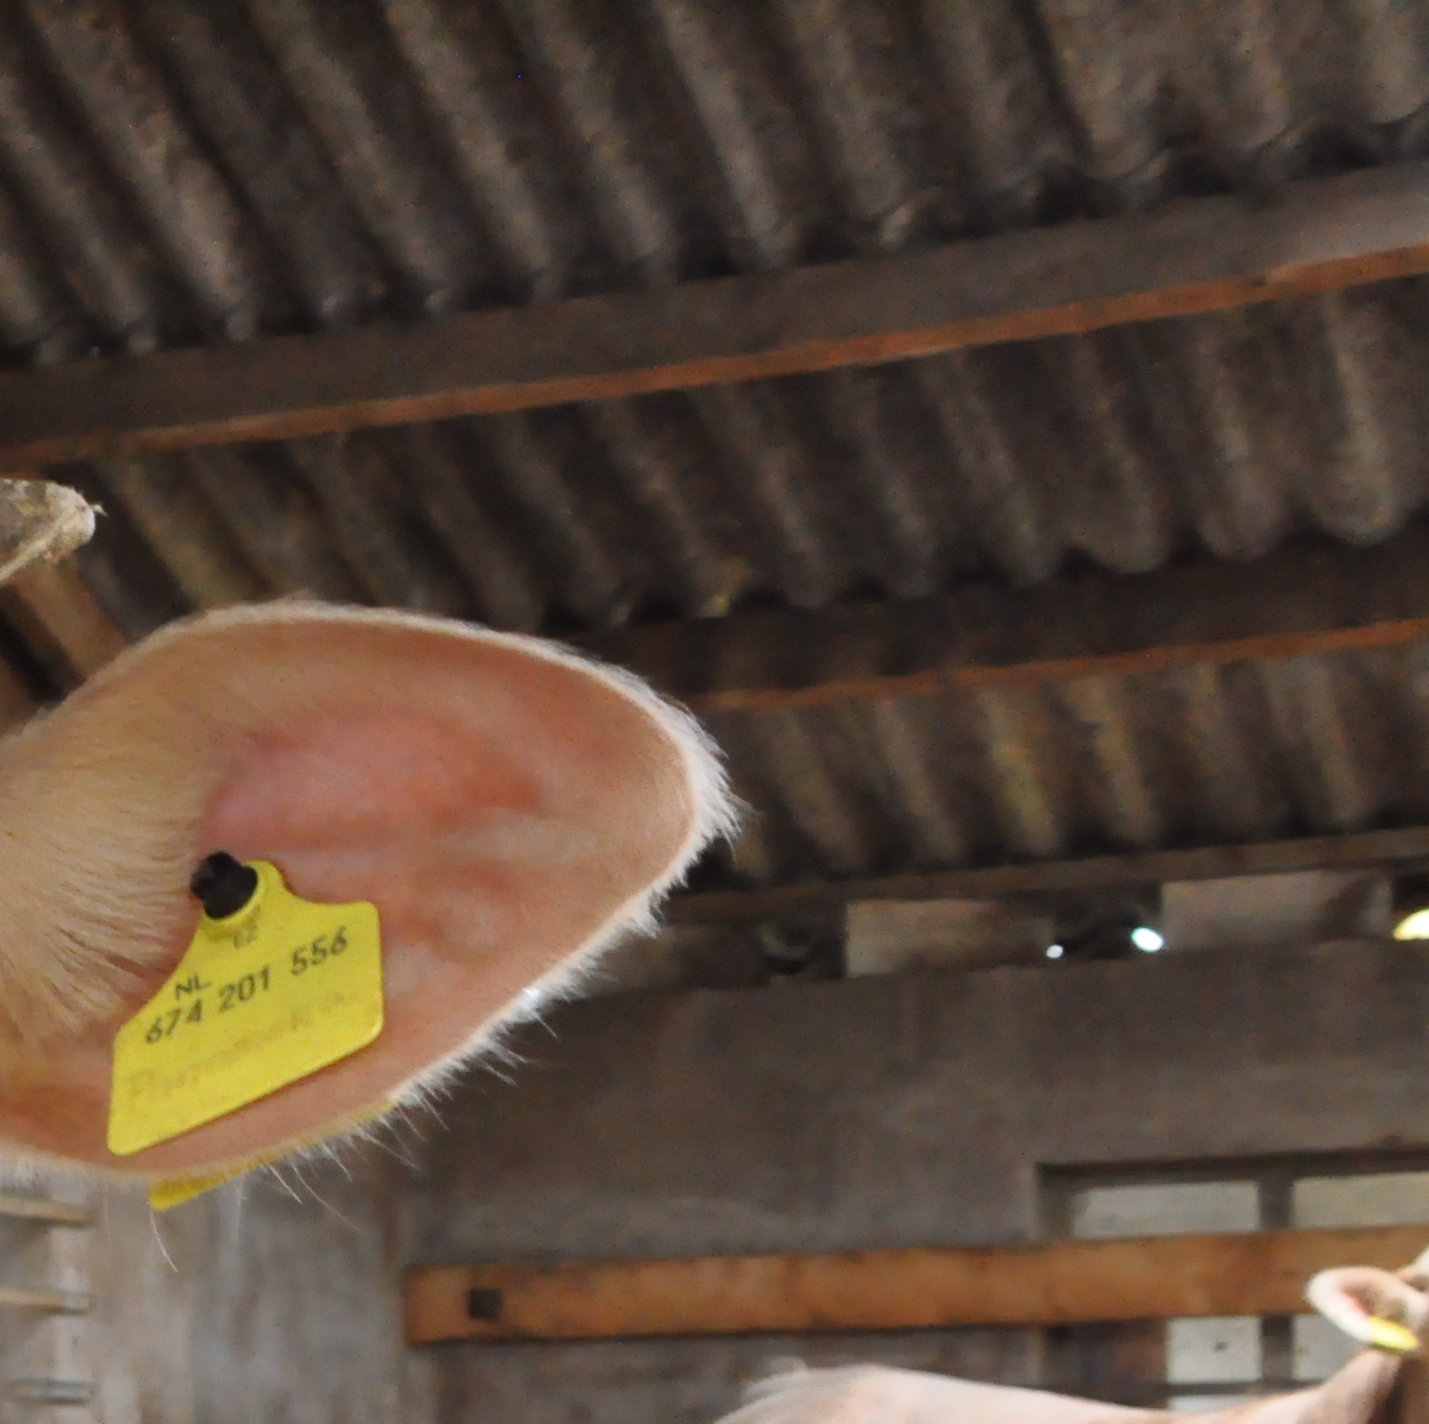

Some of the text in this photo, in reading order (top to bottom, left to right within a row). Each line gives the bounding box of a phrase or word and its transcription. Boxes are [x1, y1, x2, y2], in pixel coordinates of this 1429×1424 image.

[146, 1004, 203, 1044] 674
[218, 966, 271, 1013] 201
[291, 926, 348, 976] 556
[174, 973, 211, 1000] NL
